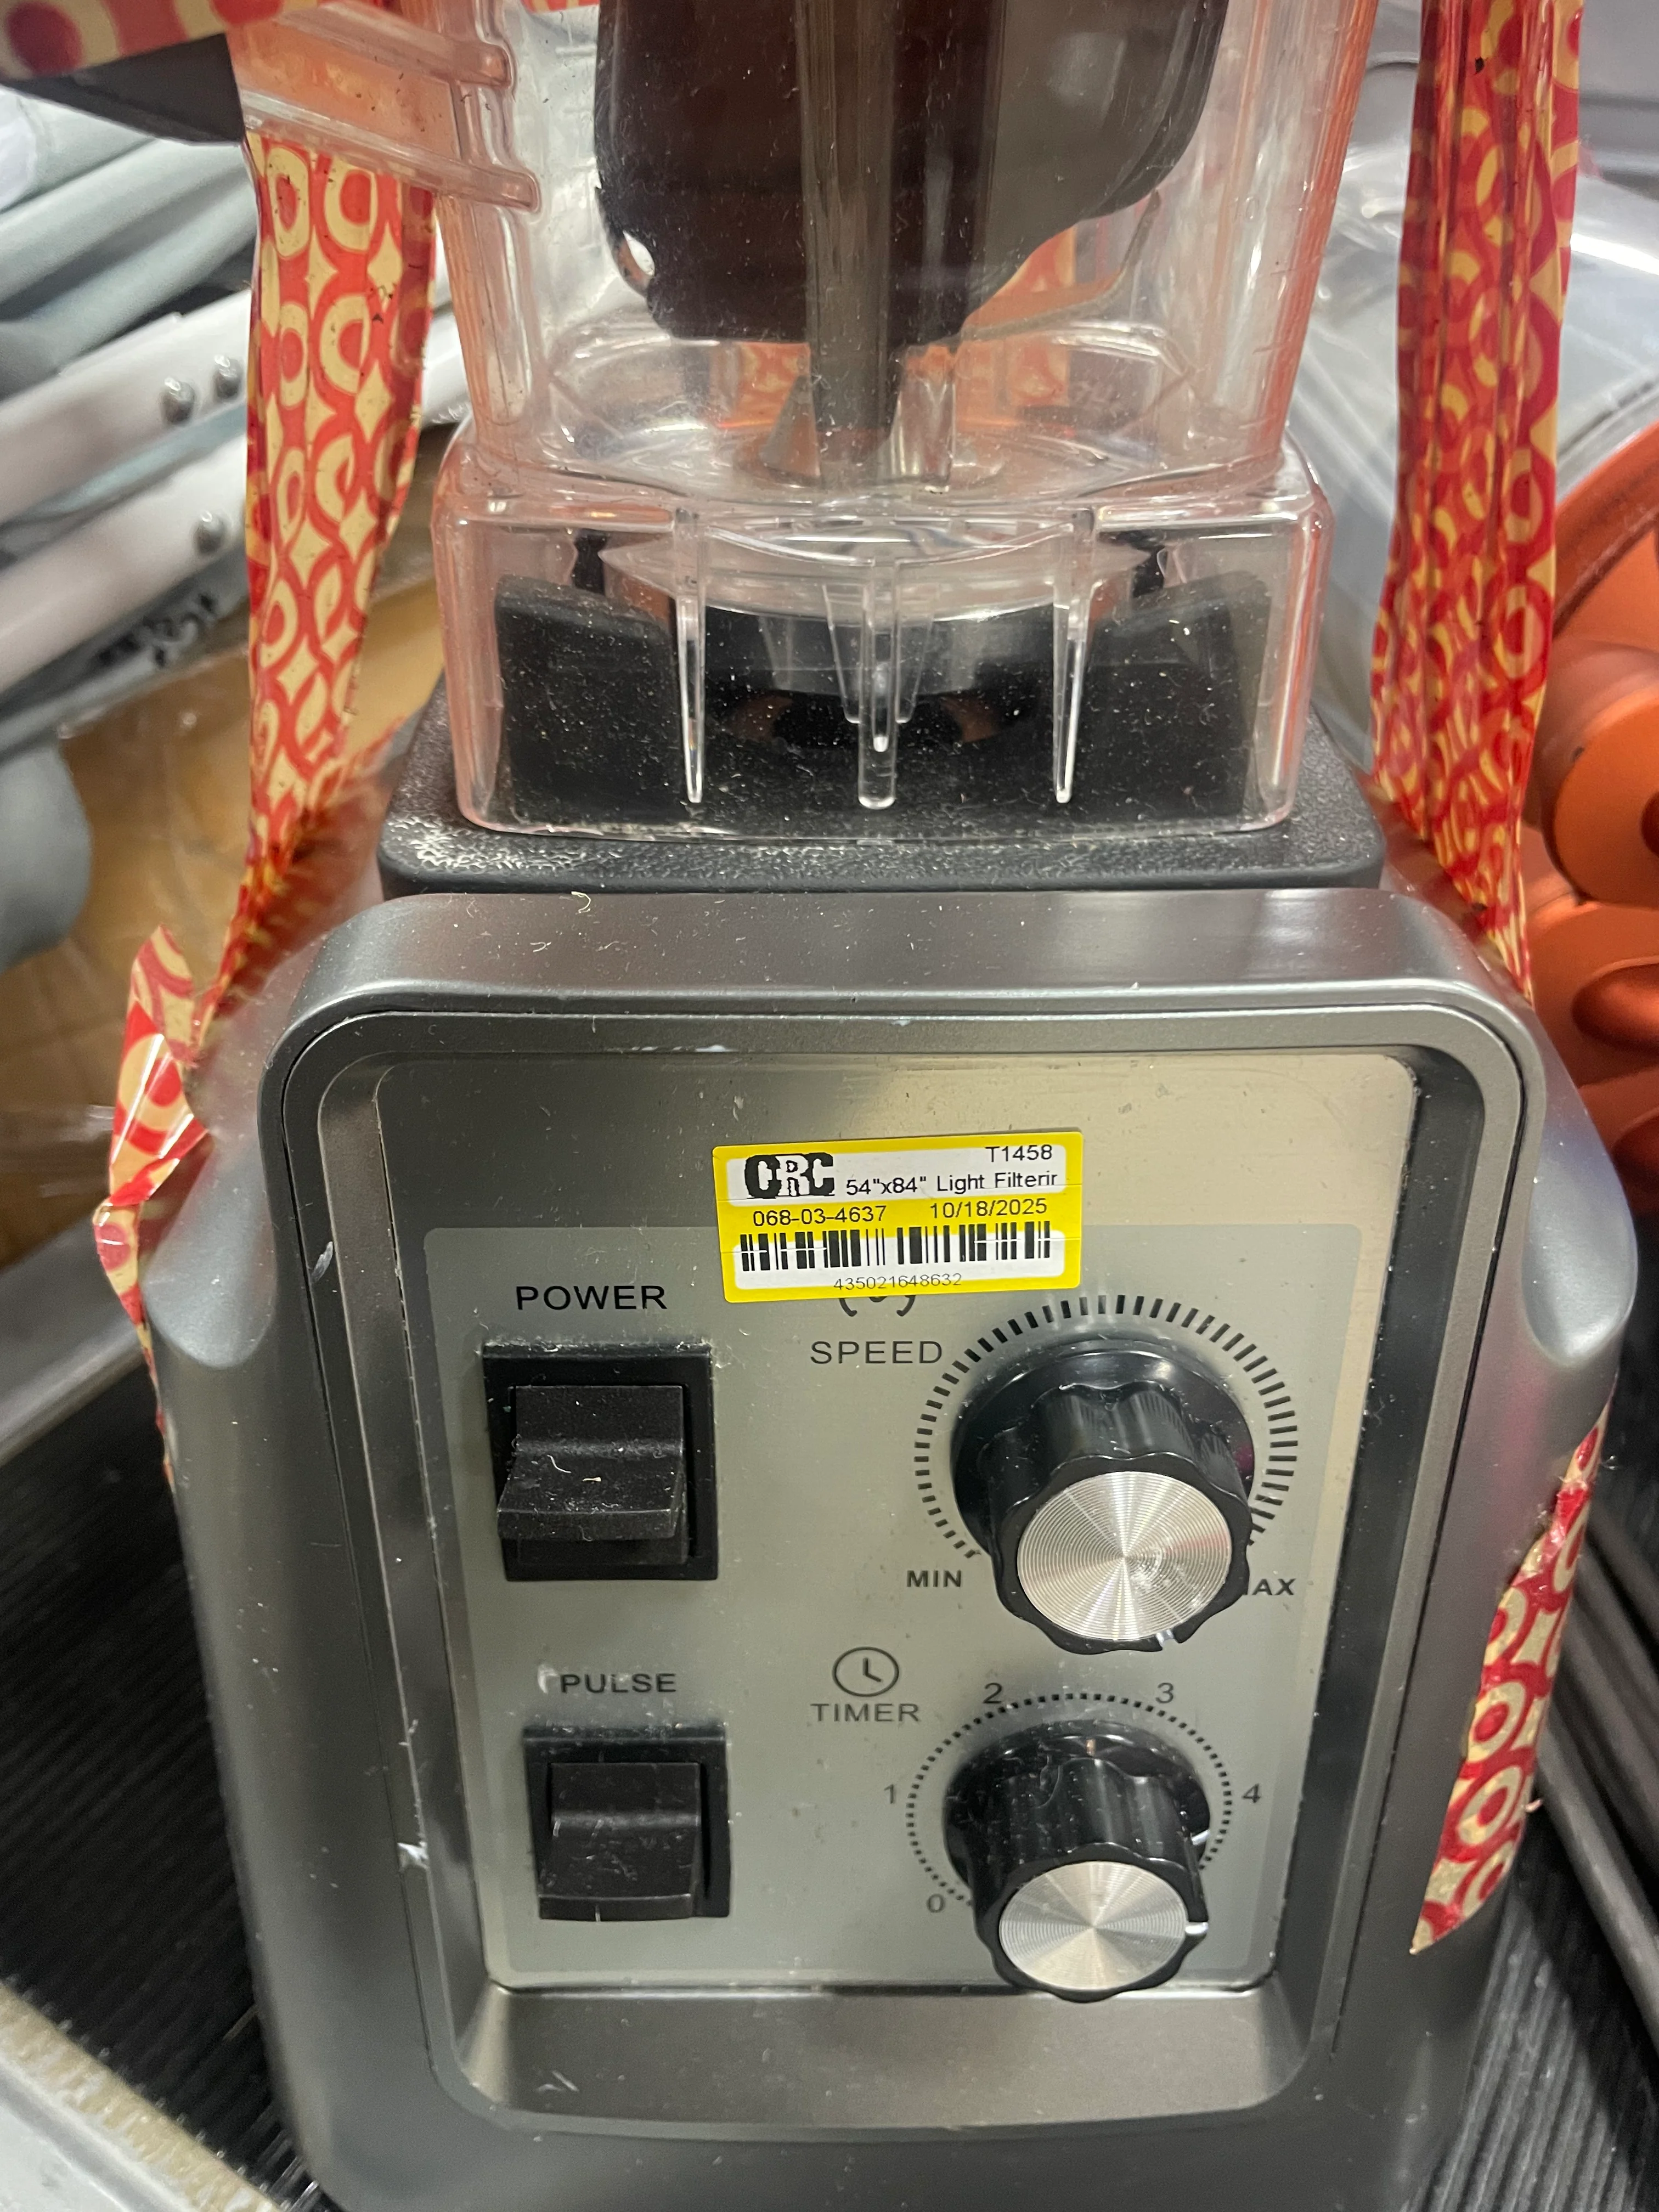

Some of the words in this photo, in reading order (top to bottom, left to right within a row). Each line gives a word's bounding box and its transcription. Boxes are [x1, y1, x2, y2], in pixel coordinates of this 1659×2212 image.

[985, 1144, 1052, 1163] T1458
[745, 1152, 835, 1199] CRC
[847, 1176, 927, 1195] 54"x84"
[937, 1174, 985, 1194] Light
[753, 1205, 887, 1227] 068-03-4637
[930, 1198, 1047, 1219] 10/18/2025
[833, 1273, 962, 1290] 435021648632
[516, 1285, 668, 1310] POWER
[810, 1341, 943, 1364] SPEED
[906, 1570, 962, 1588] MIN
[1243, 1578, 1296, 1596] AX
[560, 1673, 677, 1694] PULSE
[1156, 1683, 1175, 1703] 3
[983, 1683, 1003, 1705] 2
[810, 1703, 920, 1722] TIMER
[884, 1784, 896, 1804] 1
[1242, 1784, 1262, 1804] 4
[927, 1894, 945, 1914] 0
